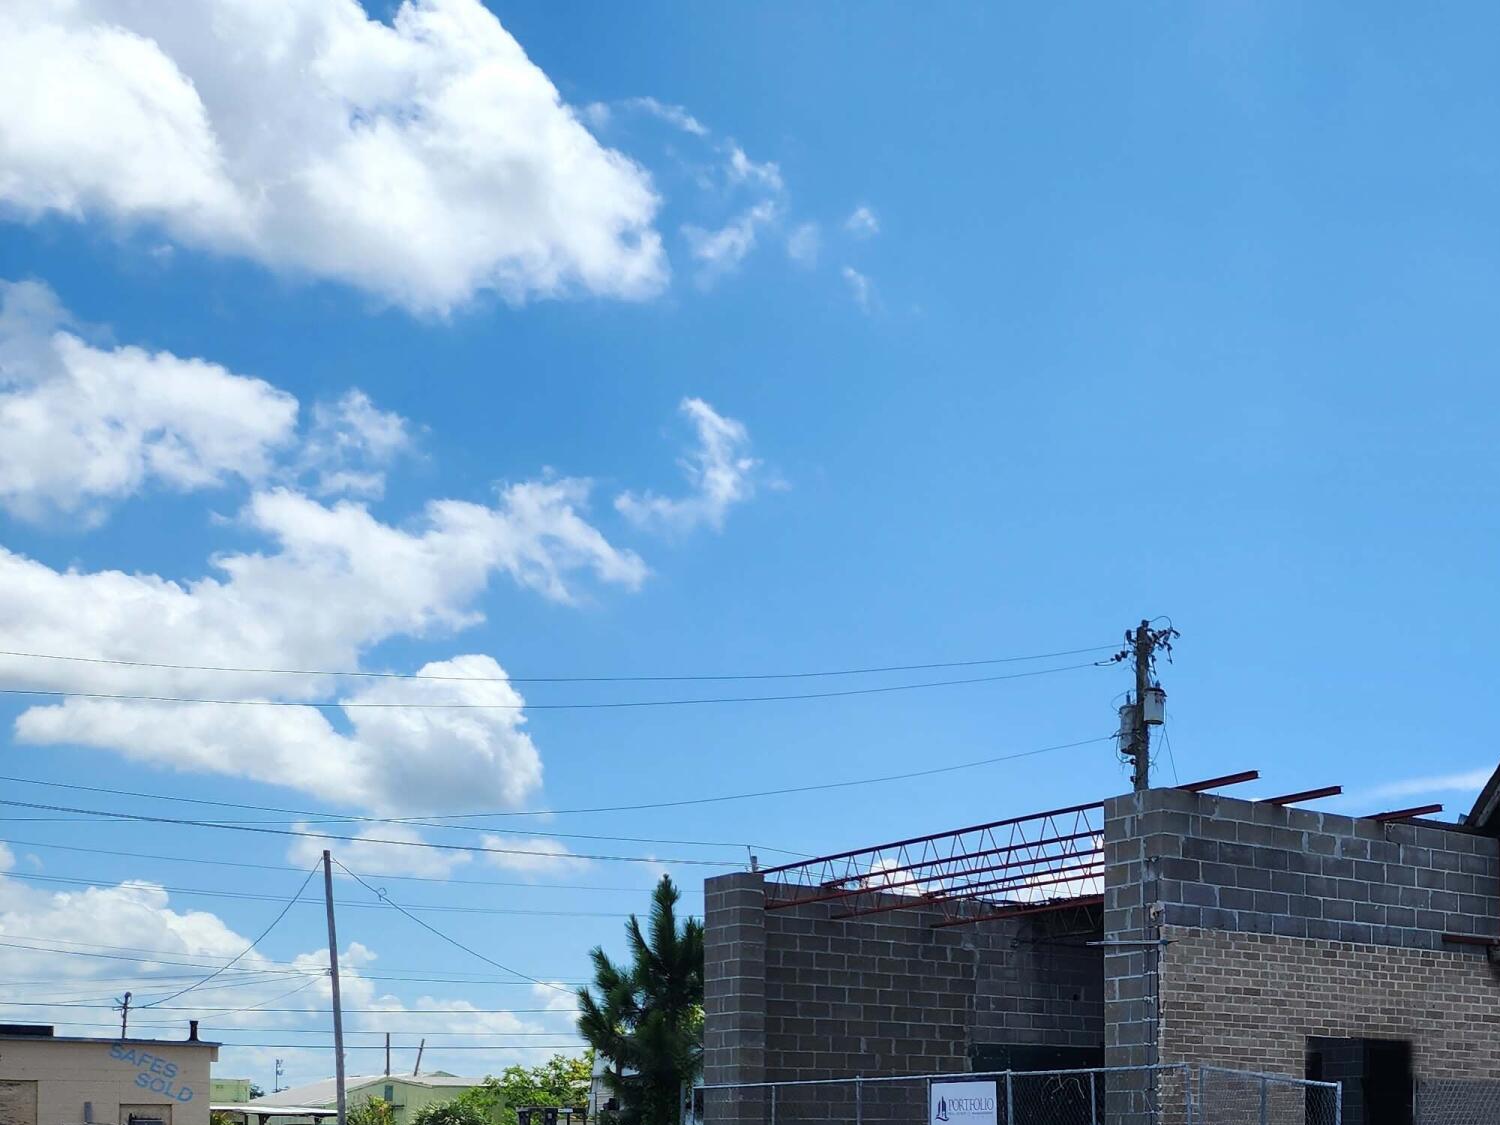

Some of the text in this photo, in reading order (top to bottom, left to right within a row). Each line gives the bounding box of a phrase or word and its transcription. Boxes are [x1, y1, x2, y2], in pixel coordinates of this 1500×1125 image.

[110, 1042, 178, 1078] SAFES
[135, 1072, 193, 1102] SOLD
[948, 1098, 994, 1111] PORTFOLIO
